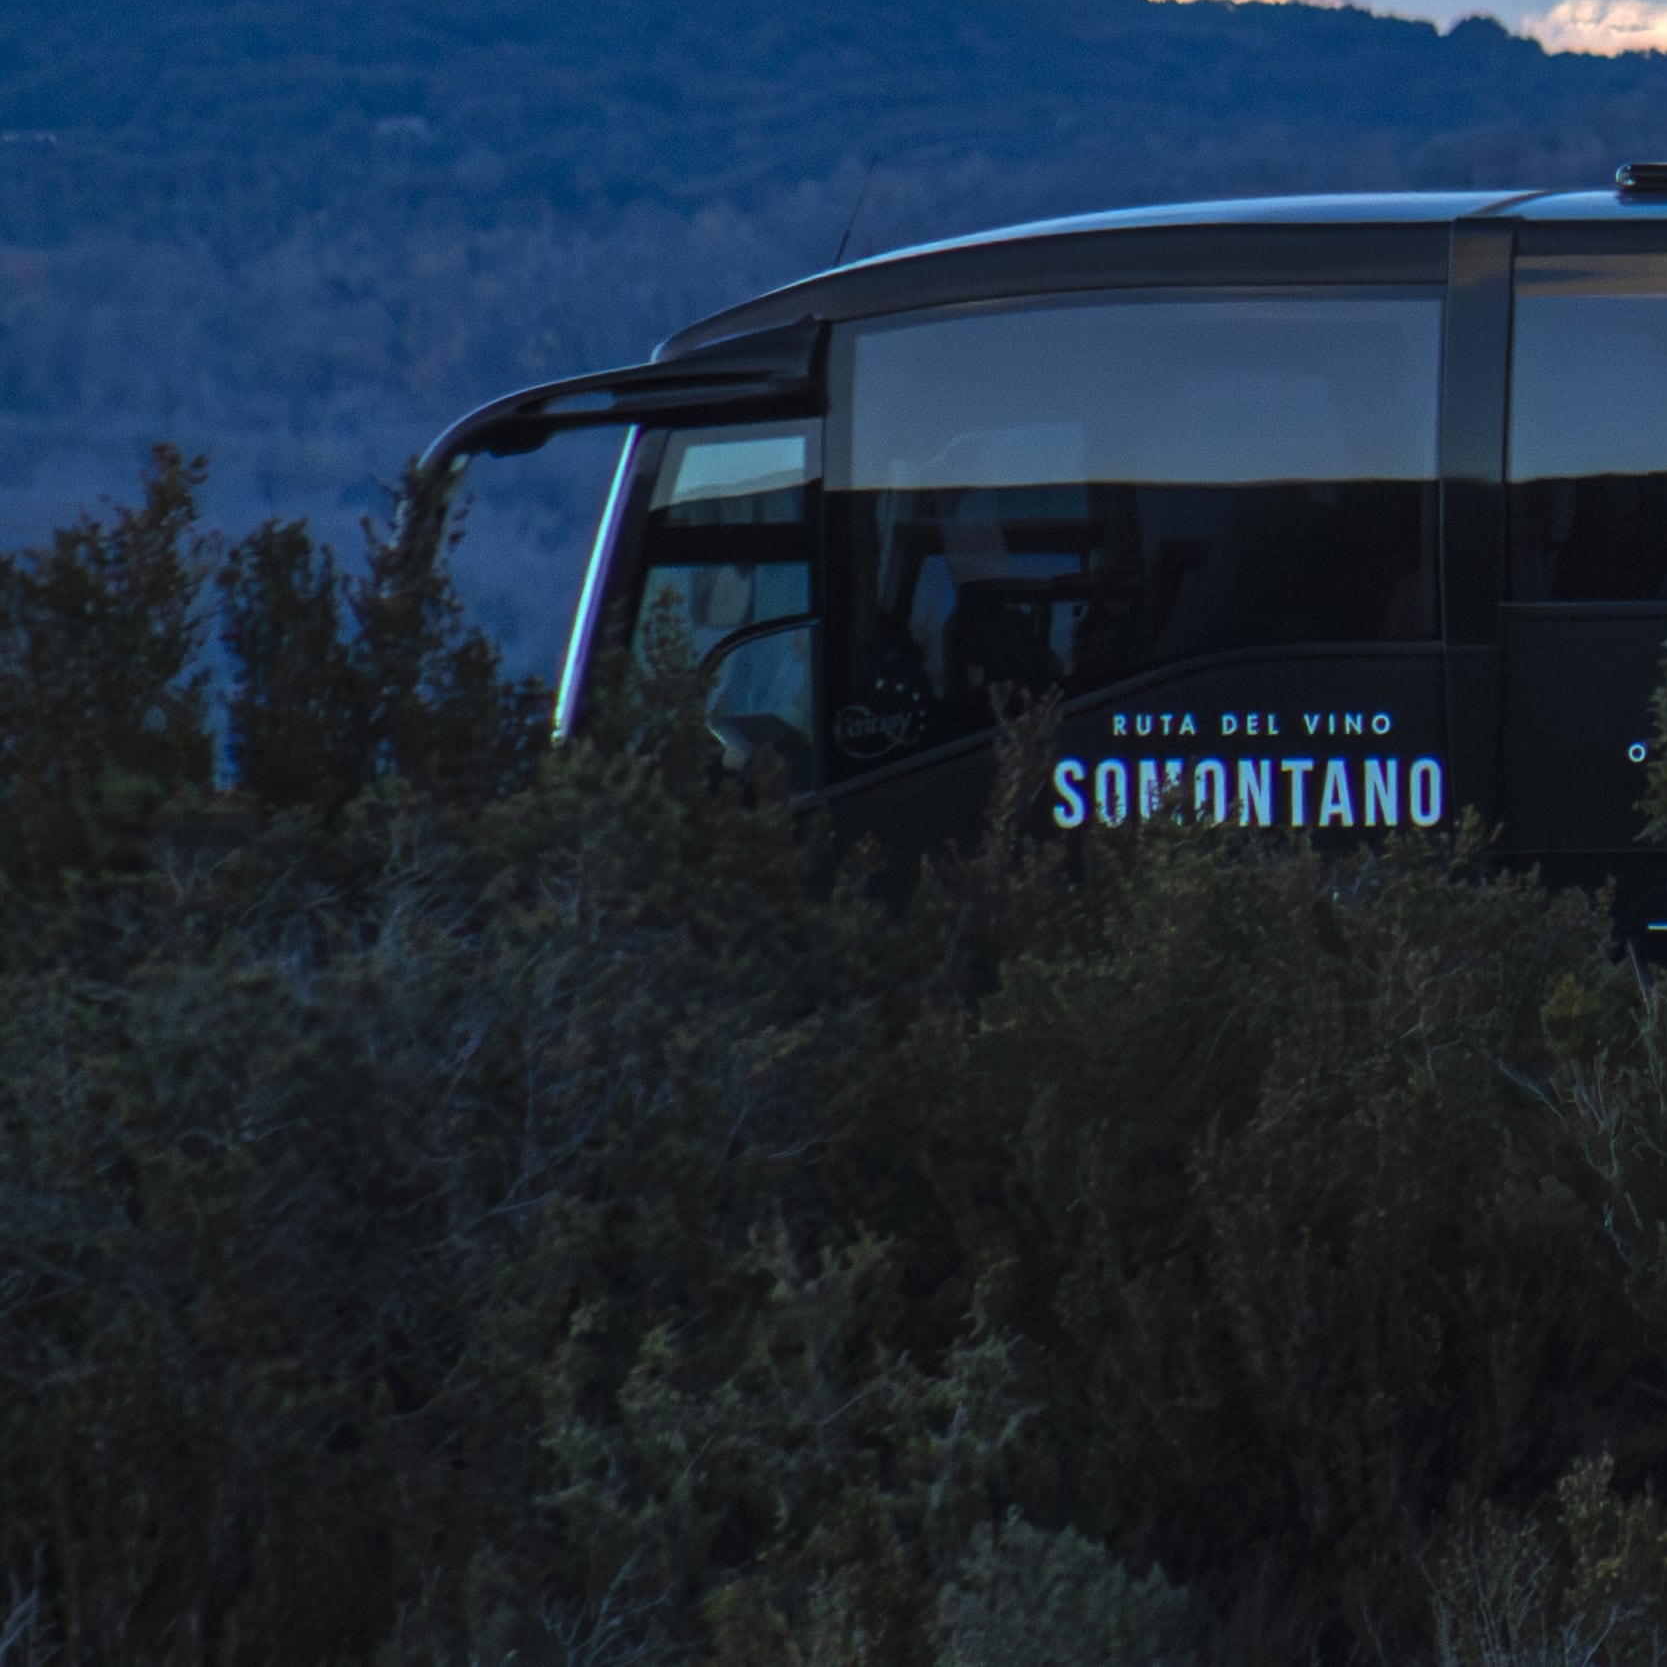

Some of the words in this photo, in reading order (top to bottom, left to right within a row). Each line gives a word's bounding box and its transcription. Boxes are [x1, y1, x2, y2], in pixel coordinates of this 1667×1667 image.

[1113, 713, 1196, 735] RUTA
[1221, 713, 1279, 735] DEL
[1304, 713, 1391, 735] VINO
